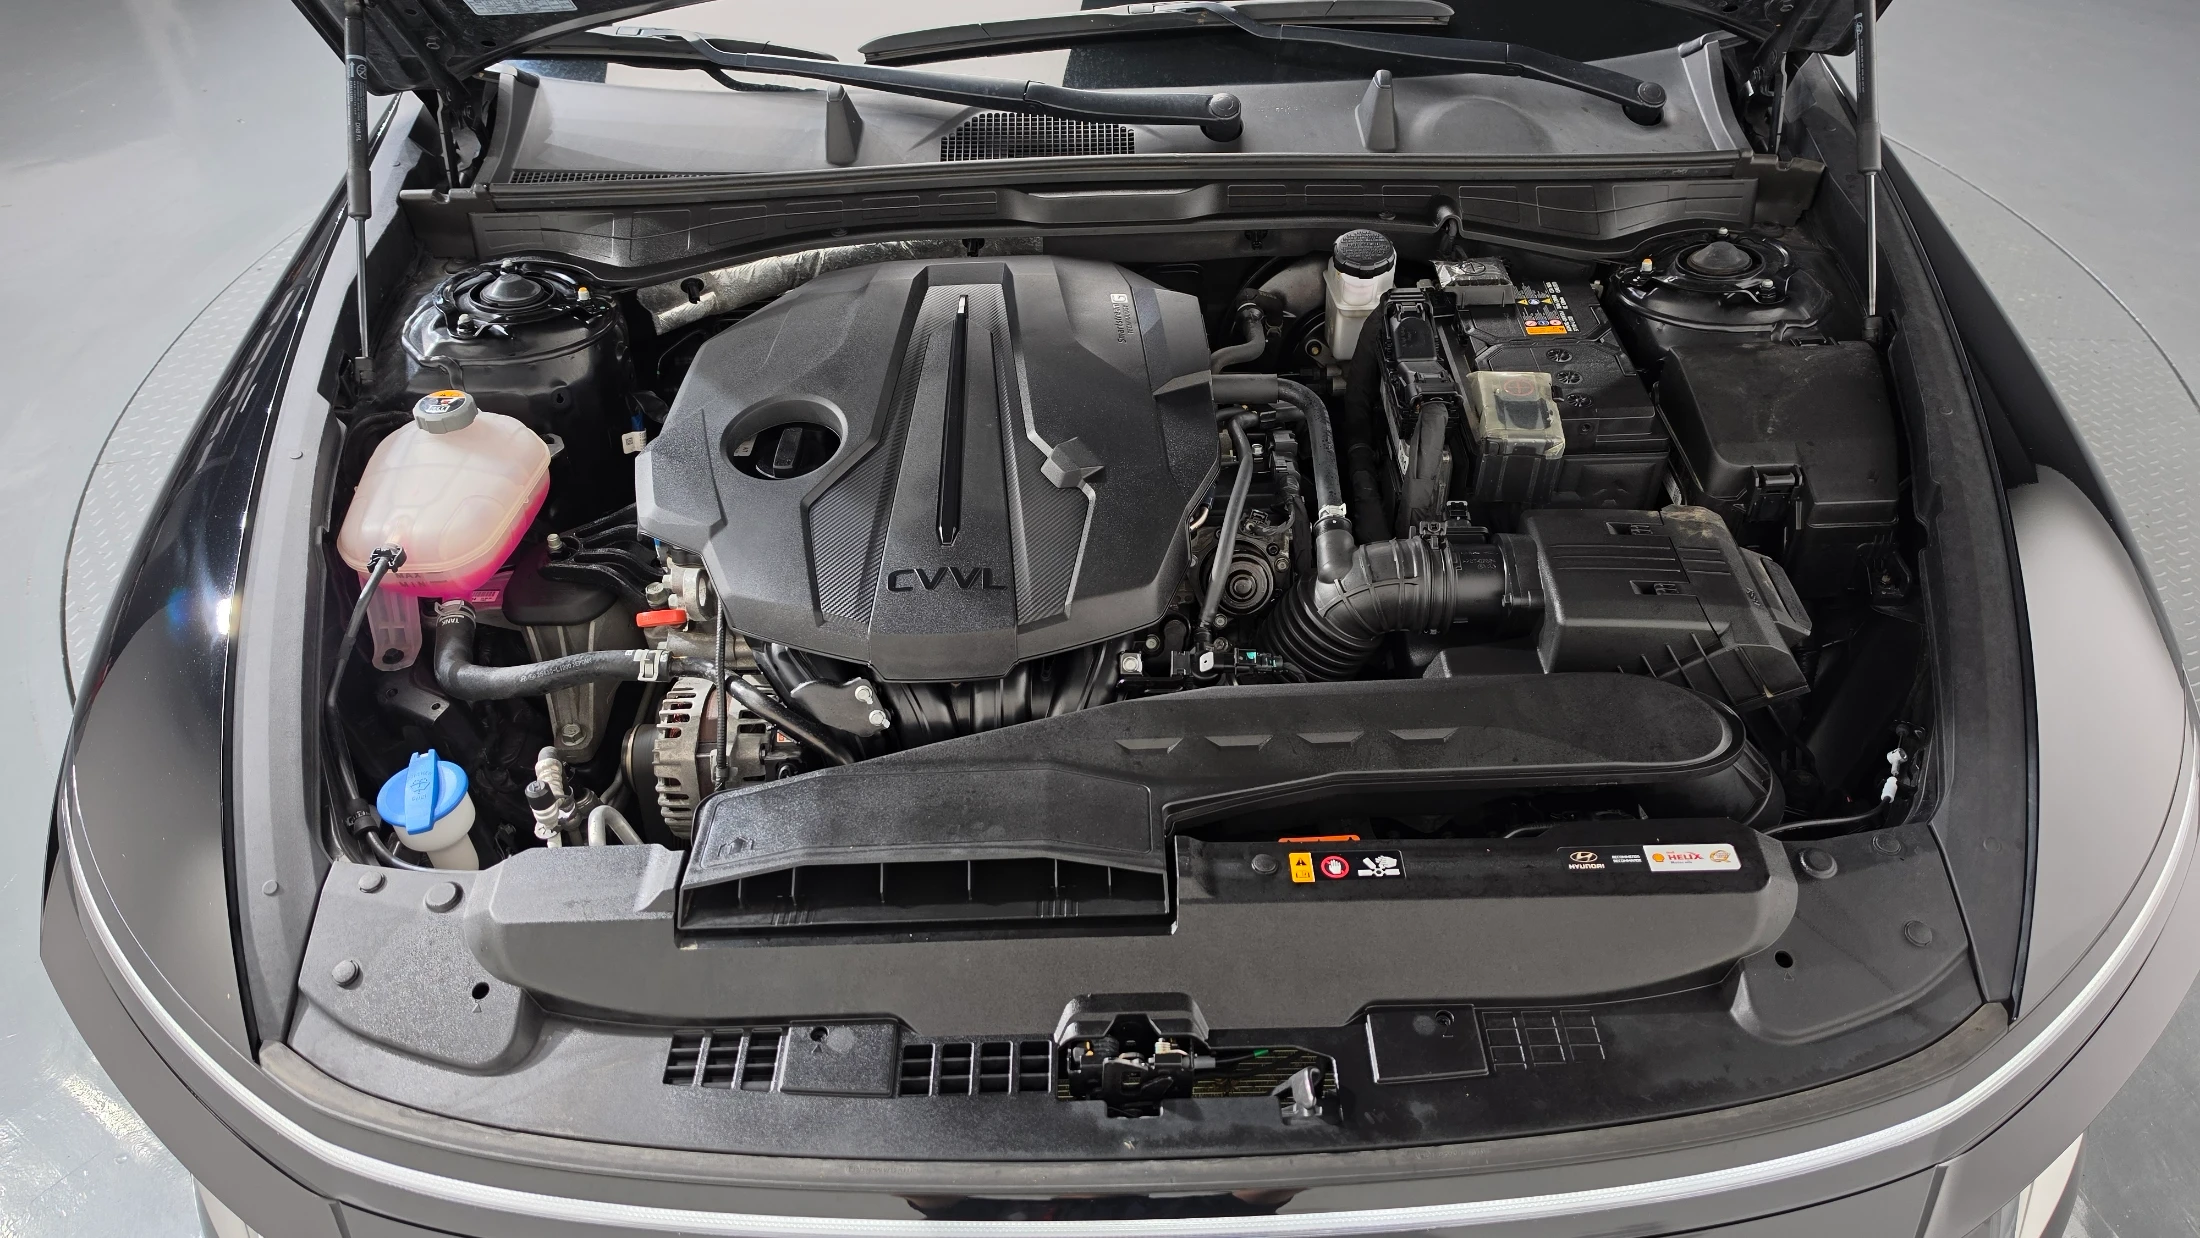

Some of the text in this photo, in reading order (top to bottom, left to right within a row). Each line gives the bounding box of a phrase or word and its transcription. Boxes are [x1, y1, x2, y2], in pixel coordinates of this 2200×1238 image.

[887, 566, 1008, 592] CVVL
[441, 617, 460, 627] TANK
[1667, 853, 1703, 861] HELIX
